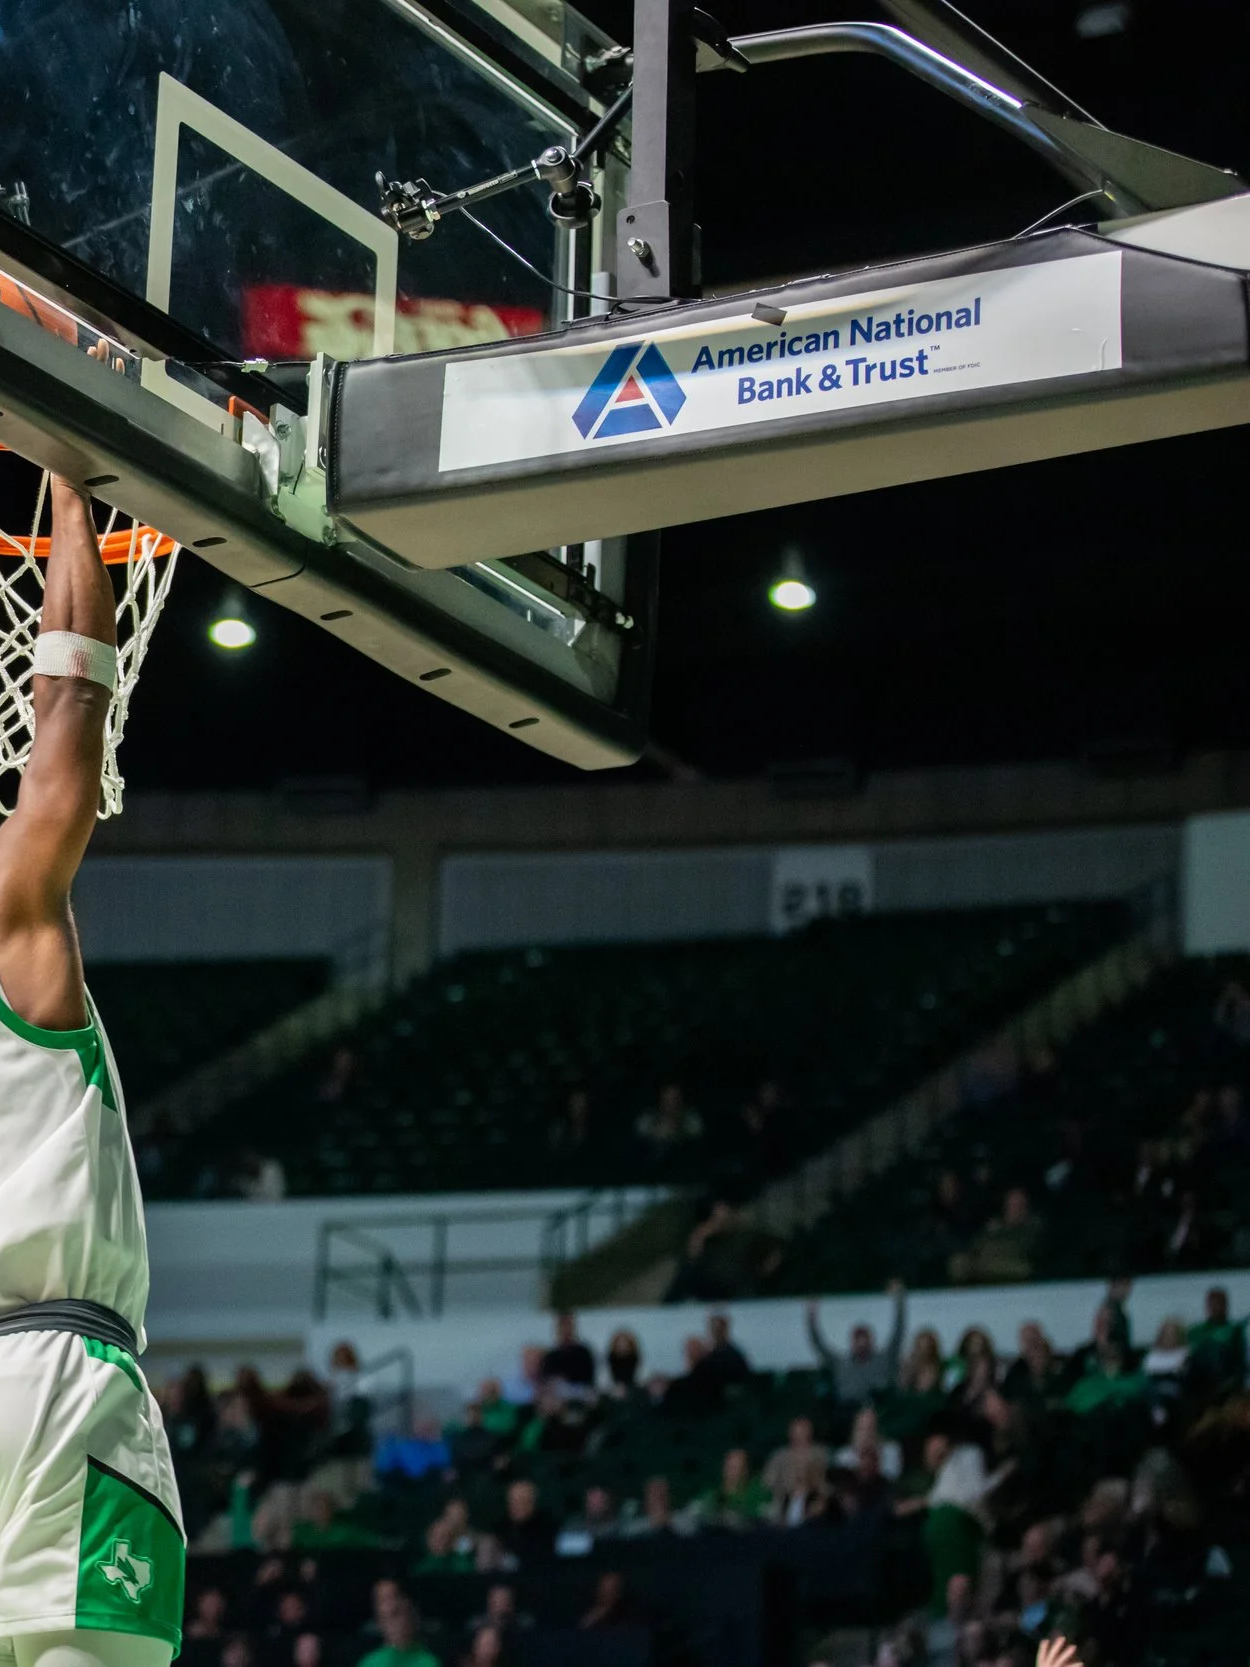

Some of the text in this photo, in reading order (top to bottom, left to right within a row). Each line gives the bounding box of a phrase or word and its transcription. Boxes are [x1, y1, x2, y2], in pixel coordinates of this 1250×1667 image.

[691, 297, 981, 373] American National
[737, 367, 812, 404] Bank
[818, 364, 842, 392] &
